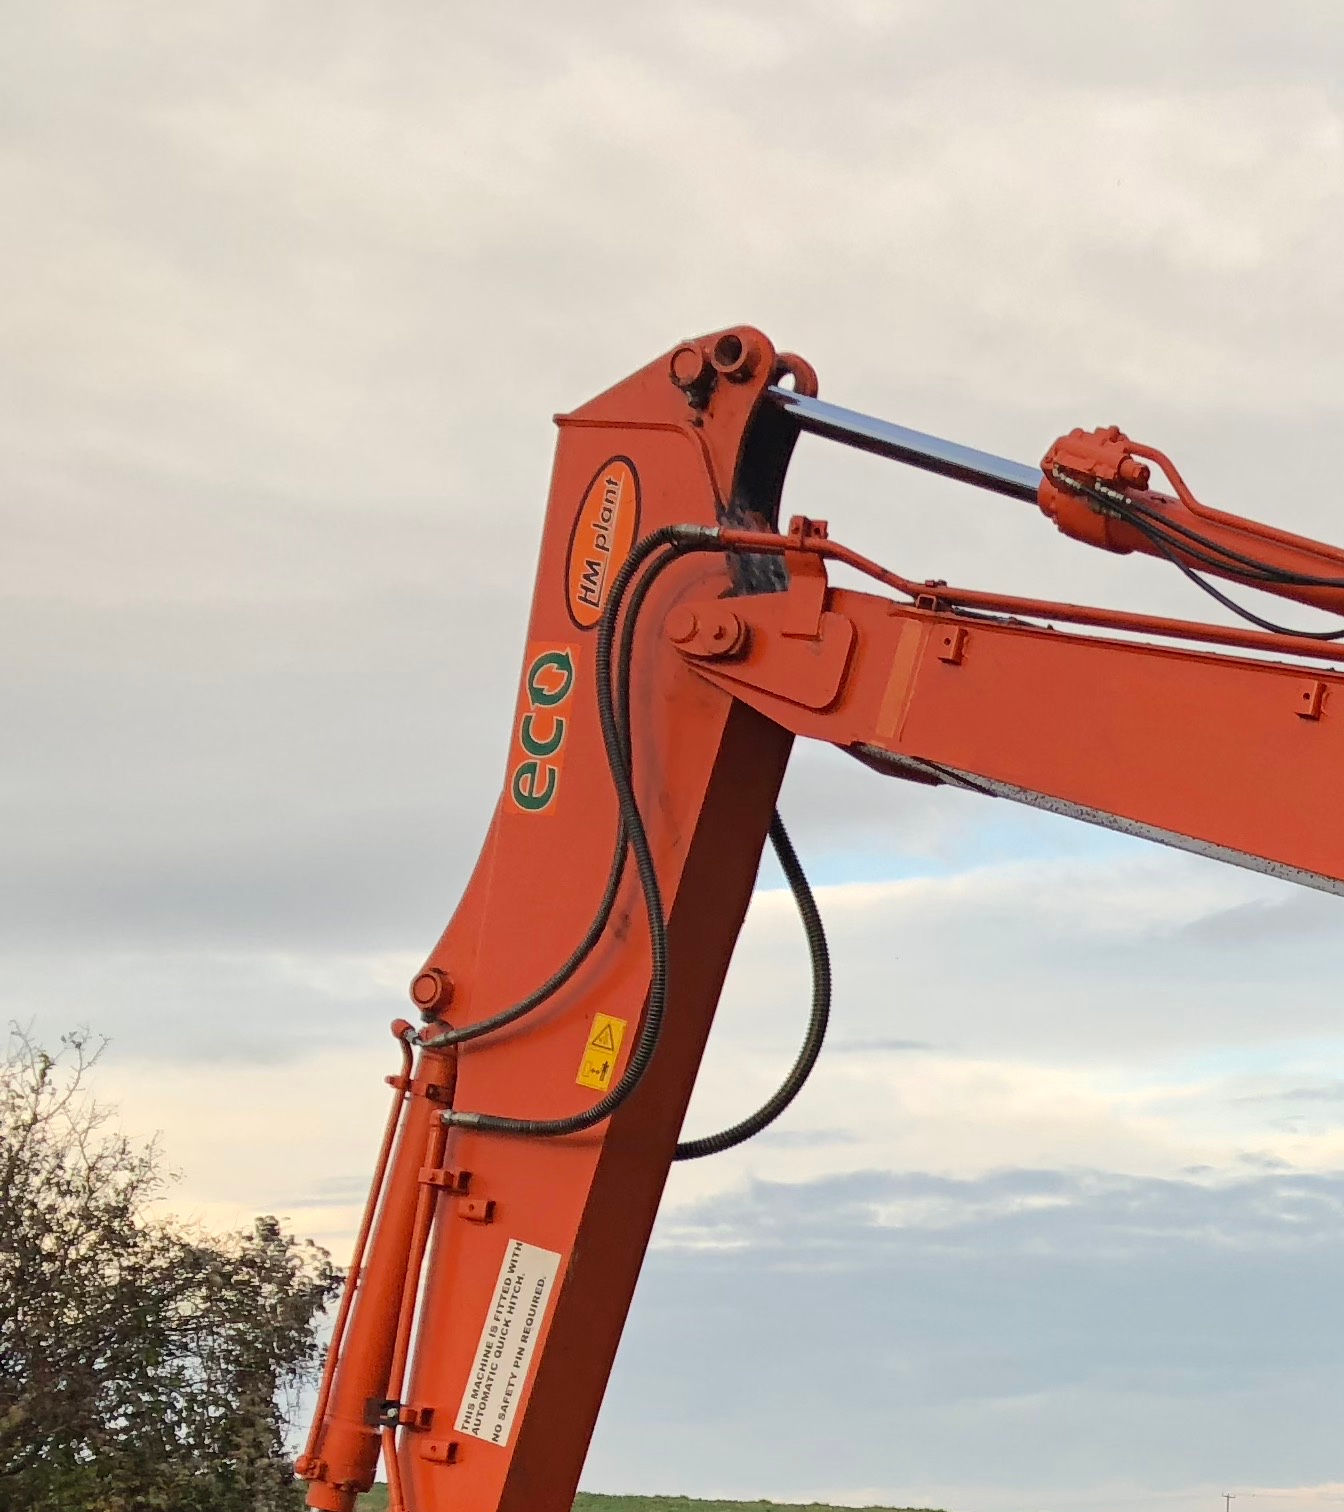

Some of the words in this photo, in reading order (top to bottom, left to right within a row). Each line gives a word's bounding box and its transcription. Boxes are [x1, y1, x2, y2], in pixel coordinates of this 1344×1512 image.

[577, 559, 602, 608] HM
[593, 477, 621, 553] plant
[512, 648, 575, 813] eco
[507, 1241, 524, 1274] WITH
[493, 1277, 512, 1322] FITTED
[471, 1362, 499, 1435] AUTOMATIC
[493, 1319, 512, 1359] QUICK
[506, 1273, 526, 1315] HITCH.
[488, 1326, 499, 1338] IS
[491, 1424, 503, 1443] NO
[498, 1372, 518, 1421] SAFETY
[513, 1346, 526, 1369] PIN
[520, 1276, 547, 1344] REQUIRED.
[471, 1341, 494, 1400] MACHINE
[460, 1403, 475, 1431] THIS
